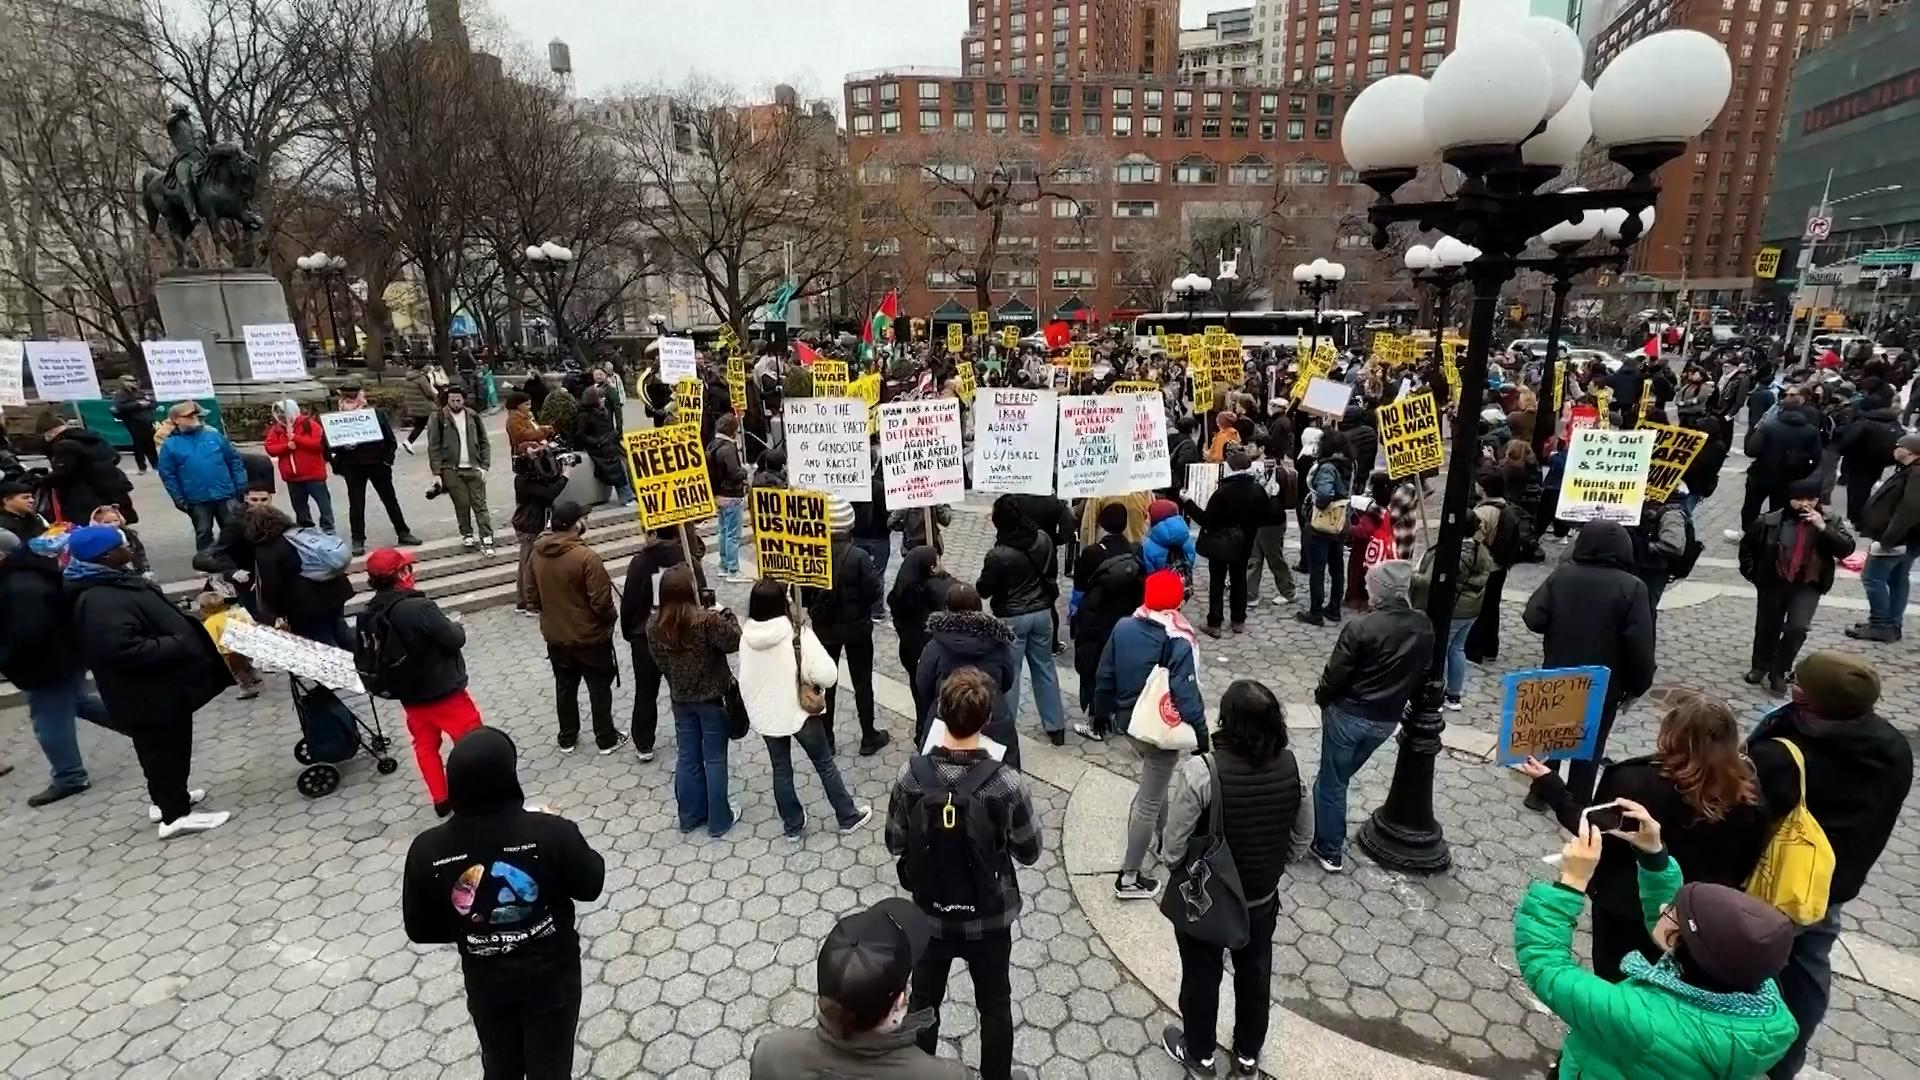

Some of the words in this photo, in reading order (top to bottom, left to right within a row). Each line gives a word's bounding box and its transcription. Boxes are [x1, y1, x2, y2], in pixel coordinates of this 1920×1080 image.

[1758, 263, 1774, 273] BUY
[815, 373, 846, 382] WAR
[995, 392, 1038, 404] DEFEND
[790, 404, 807, 415] NO
[815, 404, 828, 416] TO
[834, 404, 850, 416] THE
[1381, 405, 1398, 426] NO
[1402, 396, 1431, 421] NEW
[988, 423, 1028, 432] AGAINST
[1384, 425, 1403, 440] US
[1404, 415, 1436, 434] WAR
[995, 436, 1012, 446] THE
[1387, 441, 1404, 456] IN
[1405, 432, 1439, 450] THE
[1583, 433, 1613, 444] U.S.
[1618, 435, 1644, 444] Out
[1674, 432, 1703, 449] THE
[632, 441, 702, 479] NEEDS
[1586, 447, 1603, 456] of
[1607, 448, 1637, 459] Iraq
[1578, 460, 1590, 470] &
[1594, 463, 1639, 473] Syria!
[639, 481, 669, 494] NOT
[673, 473, 705, 486] WAR
[1573, 477, 1616, 490] Hands
[673, 483, 710, 508] IRAN
[1583, 491, 1624, 504] IRAN!
[757, 491, 781, 514] NO
[785, 495, 825, 520] NEW
[758, 515, 784, 532] US
[785, 519, 828, 538] WAR
[760, 538, 784, 552] IN
[785, 540, 829, 558] THE
[761, 553, 800, 572] MIDDLE
[802, 559, 828, 576] EAST
[1516, 680, 1565, 698] STOP
[1521, 695, 1565, 712] WAR
[1515, 713, 1534, 728] ON
